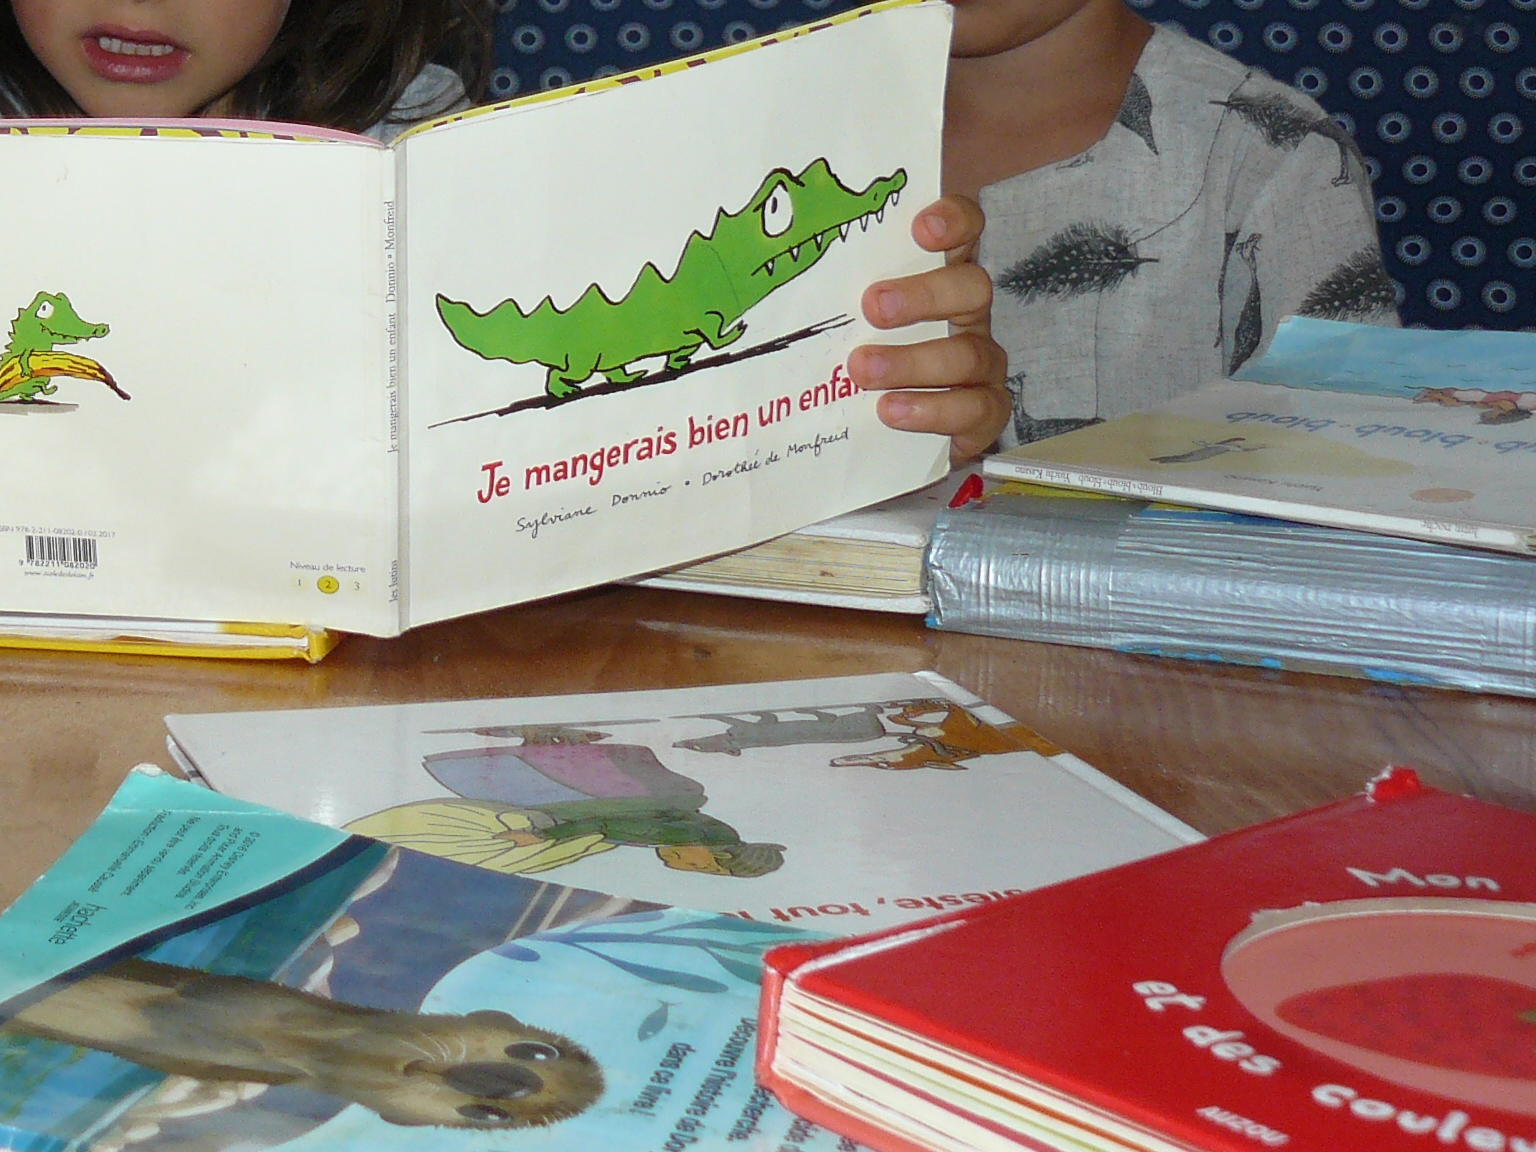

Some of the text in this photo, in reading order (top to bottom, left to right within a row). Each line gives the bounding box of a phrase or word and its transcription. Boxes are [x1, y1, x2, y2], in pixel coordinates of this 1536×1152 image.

[384, 200, 395, 251] Monfreid
[385, 260, 396, 303] Donnio
[385, 313, 396, 346] enfant
[389, 348, 396, 362] un
[386, 365, 396, 388] bien
[477, 363, 867, 504] Je mangerais bien un enfa
[1226, 411, 1336, 432] bloub
[1354, 423, 1473, 449] bloub
[516, 504, 597, 538] Sylviane
[765, 450, 781, 466] de
[1078, 474, 1102, 488] bloub
[289, 561, 366, 573] Niveau de lecture
[354, 581, 360, 591] 3
[1345, 866, 1501, 892] Mon
[47, 900, 106, 947] hachette
[769, 902, 871, 922] tout
[1131, 979, 1207, 1012] et
[1182, 1024, 1283, 1077] des
[659, 1042, 696, 1070] dans
[650, 1068, 675, 1085] ce
[633, 1084, 672, 1110] livre
